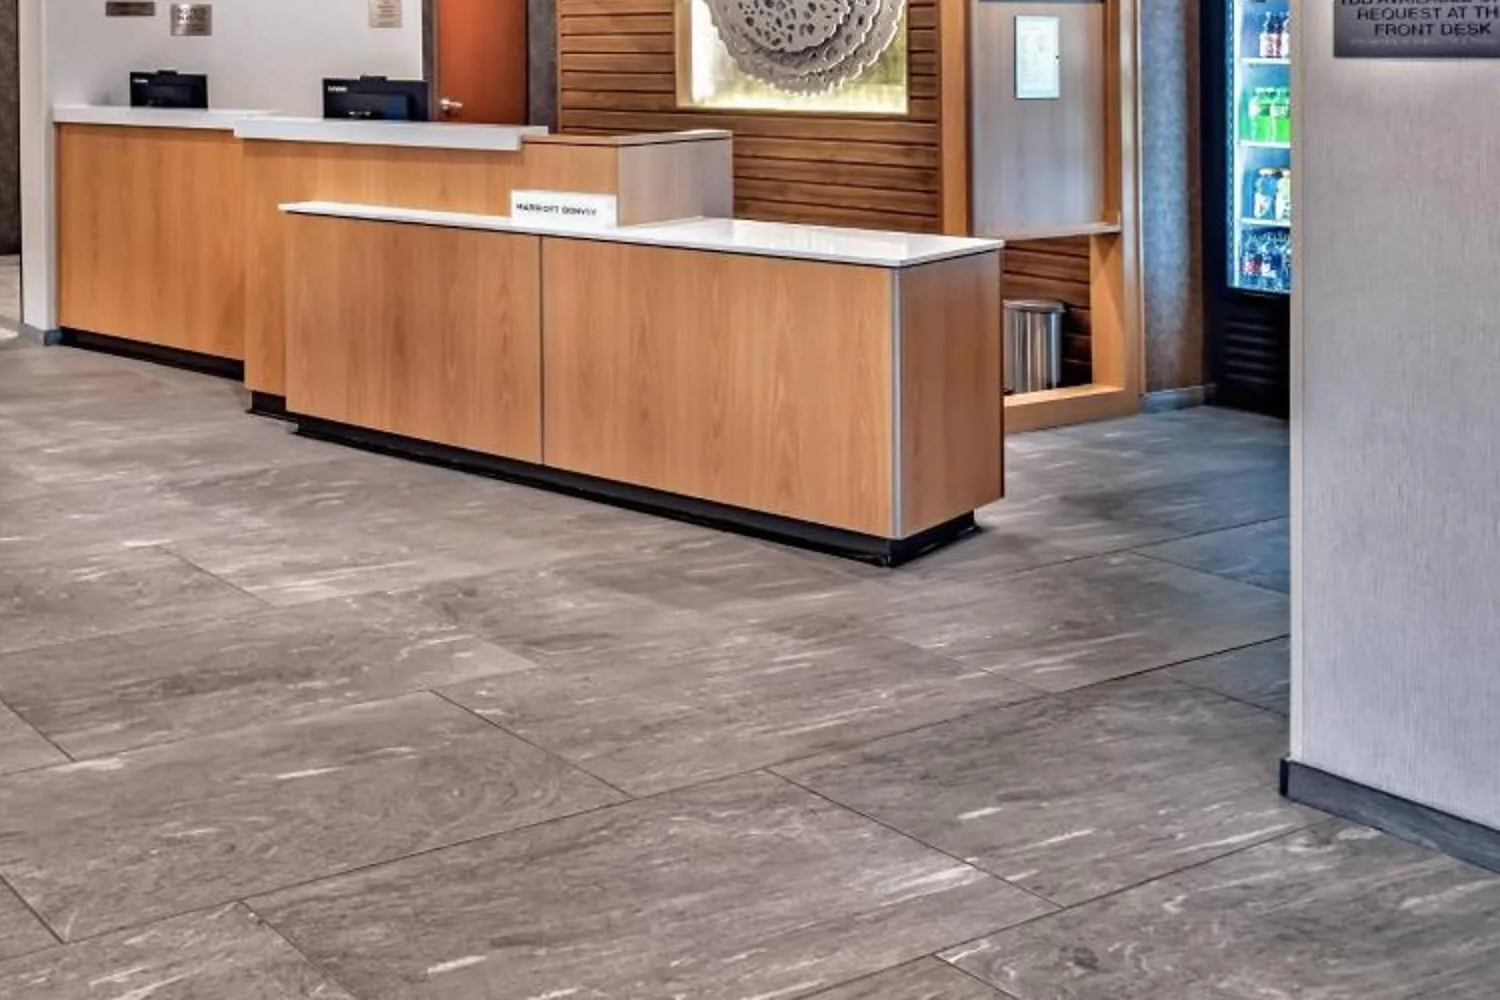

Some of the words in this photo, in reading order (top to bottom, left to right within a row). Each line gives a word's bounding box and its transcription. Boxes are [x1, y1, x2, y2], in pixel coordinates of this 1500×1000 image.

[1357, 6, 1442, 21] REQUEST
[1447, 6, 1468, 19] AT
[1374, 23, 1436, 37] FRONT
[1441, 22, 1492, 37] DESK
